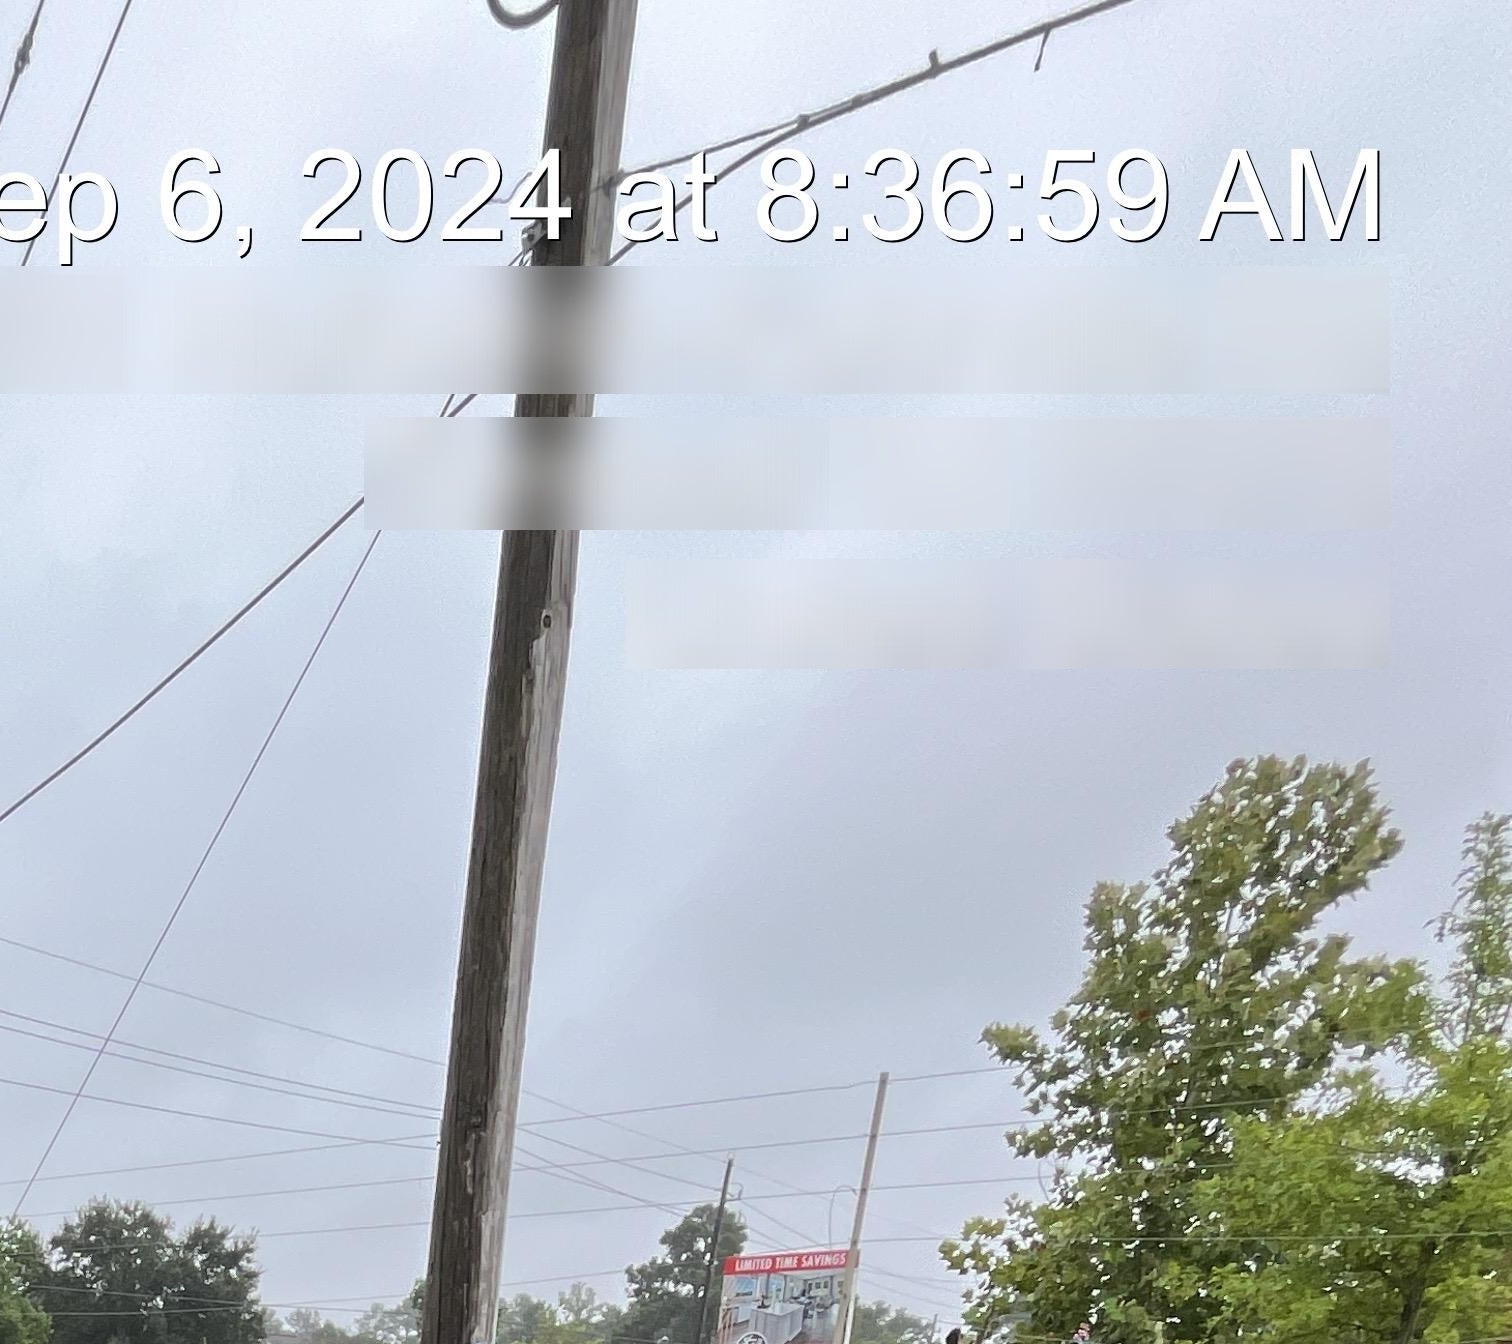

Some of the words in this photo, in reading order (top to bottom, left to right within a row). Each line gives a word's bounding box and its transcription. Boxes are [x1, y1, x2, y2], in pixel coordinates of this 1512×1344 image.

[734, 1257, 773, 1272] LIMITED
[775, 1255, 799, 1270] TIME
[801, 1252, 847, 1268] SAVINGS
